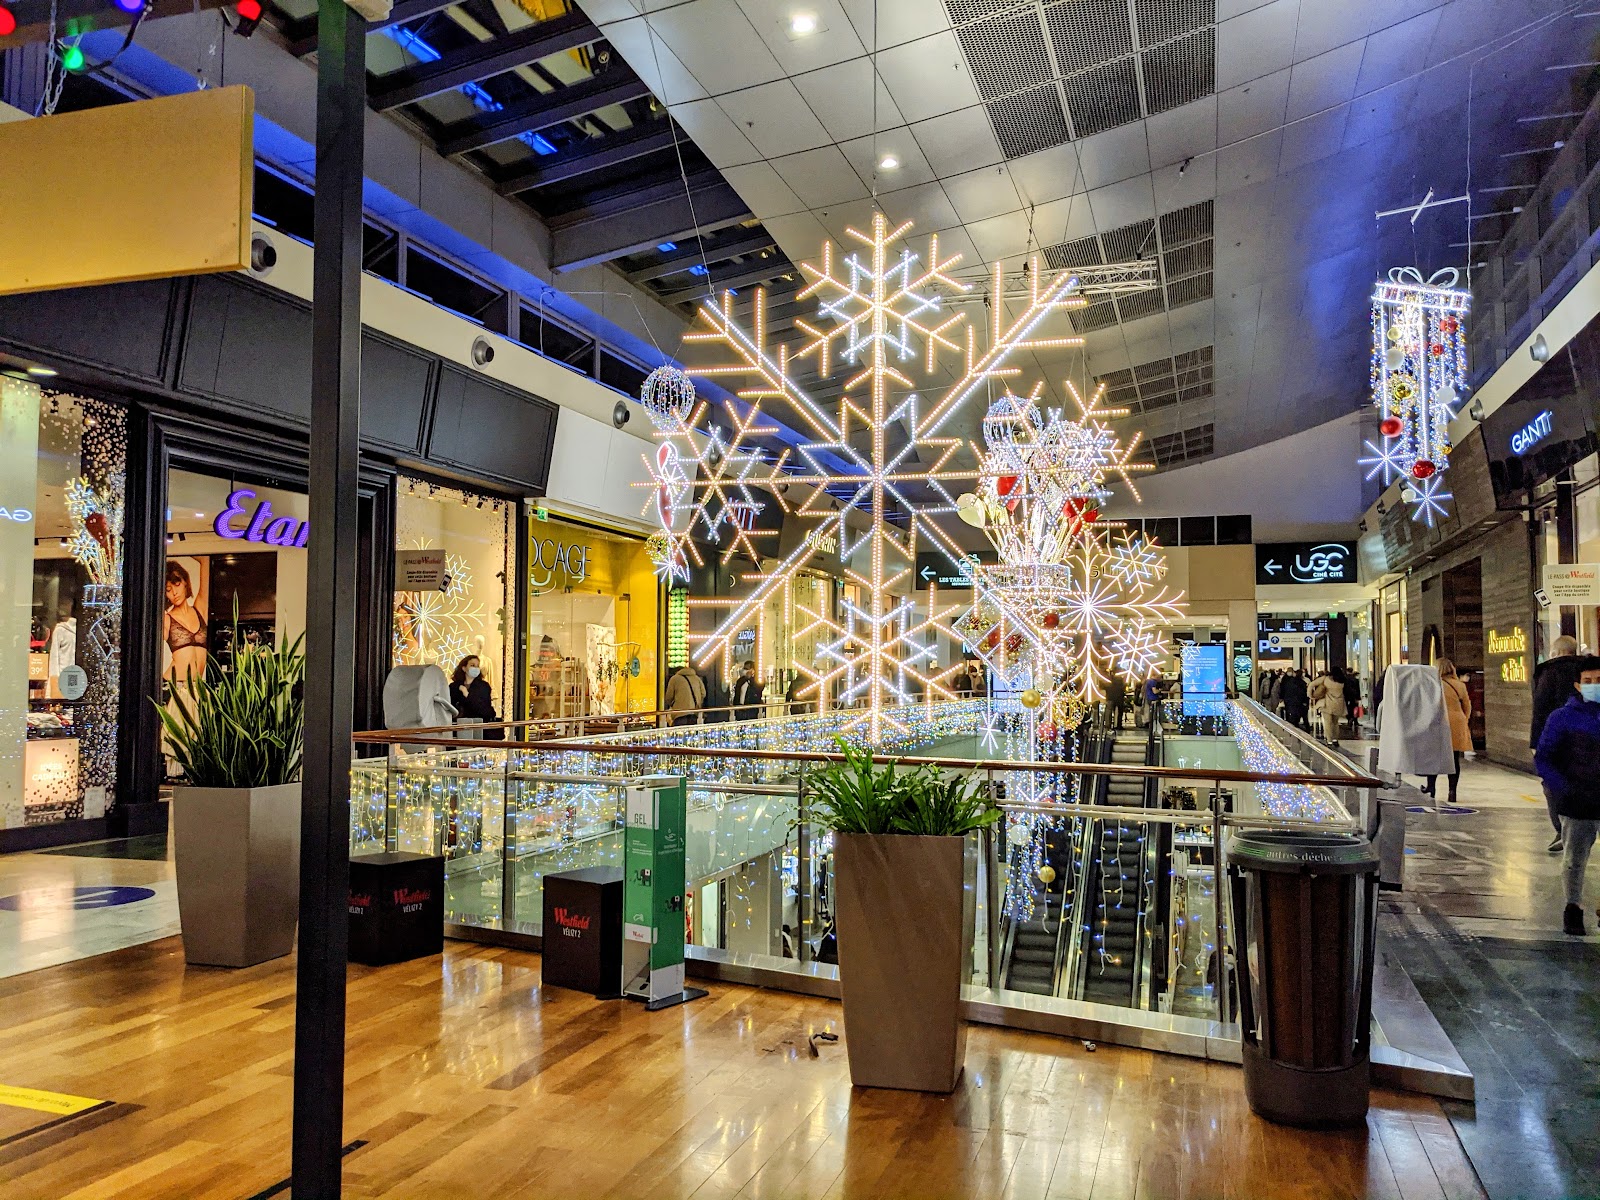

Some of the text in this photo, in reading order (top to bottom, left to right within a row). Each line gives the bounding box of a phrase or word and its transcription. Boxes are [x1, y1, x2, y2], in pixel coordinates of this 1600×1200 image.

[1511, 411, 1551, 453] GANT
[213, 489, 310, 547] Eta
[1295, 552, 1344, 571] UGC
[634, 813, 647, 825] GEL
[1266, 851, 1343, 862] autres déche
[554, 907, 590, 929] Westfield
[562, 926, 582, 938] VÉLIZY 2
